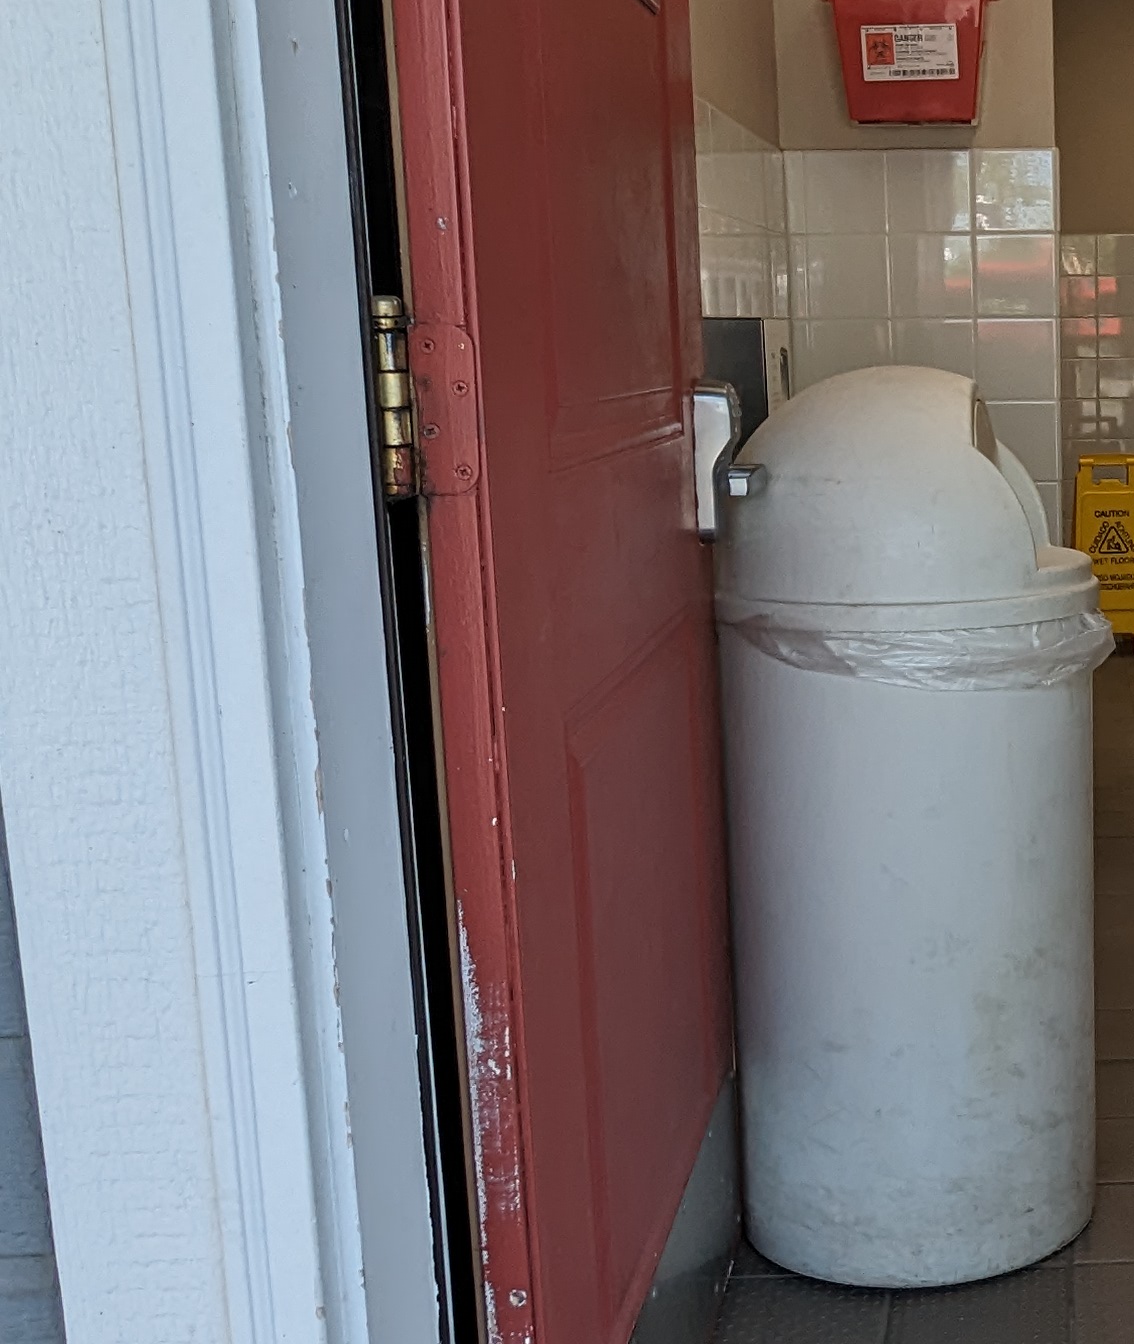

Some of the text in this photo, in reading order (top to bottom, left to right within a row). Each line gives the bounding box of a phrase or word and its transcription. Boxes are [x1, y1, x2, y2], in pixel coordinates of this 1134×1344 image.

[1094, 509, 1130, 518] CAUTION
[1089, 520, 1110, 554] CUIDADO
[1110, 556, 1134, 565] FLOOR
